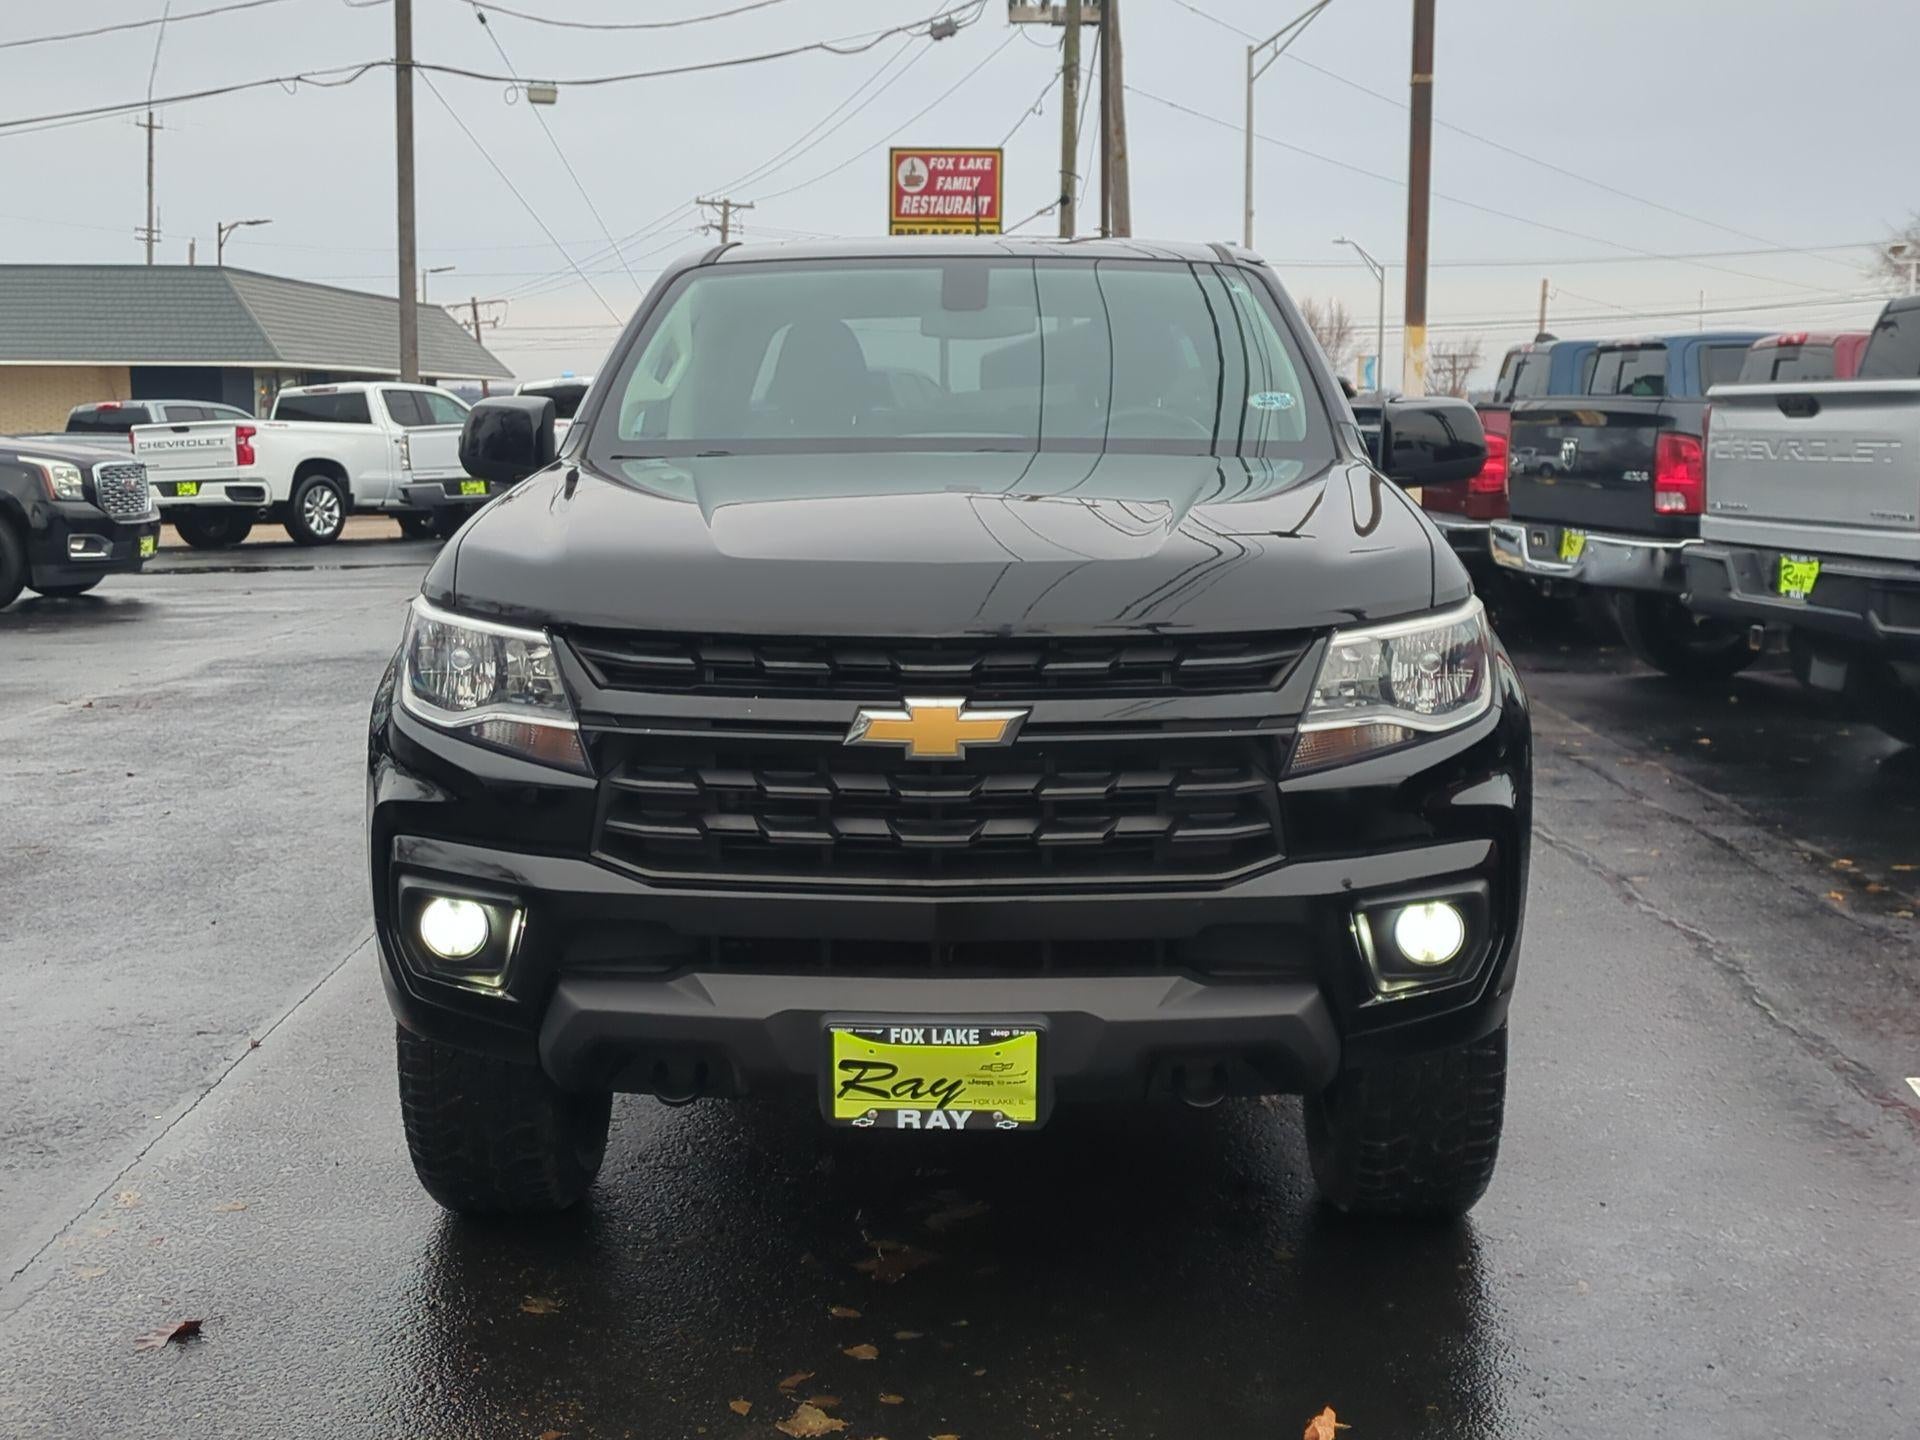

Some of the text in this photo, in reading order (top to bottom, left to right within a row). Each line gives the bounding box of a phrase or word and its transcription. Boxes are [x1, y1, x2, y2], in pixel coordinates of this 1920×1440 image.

[929, 157, 993, 171] FOX LAKE
[935, 176, 981, 191] FAMILY
[138, 438, 225, 451] CHEVROLET
[890, 1028, 926, 1045] FOX
[931, 1028, 980, 1045] LAKE
[836, 1059, 966, 1109] Ray
[897, 1109, 974, 1130] RAY
